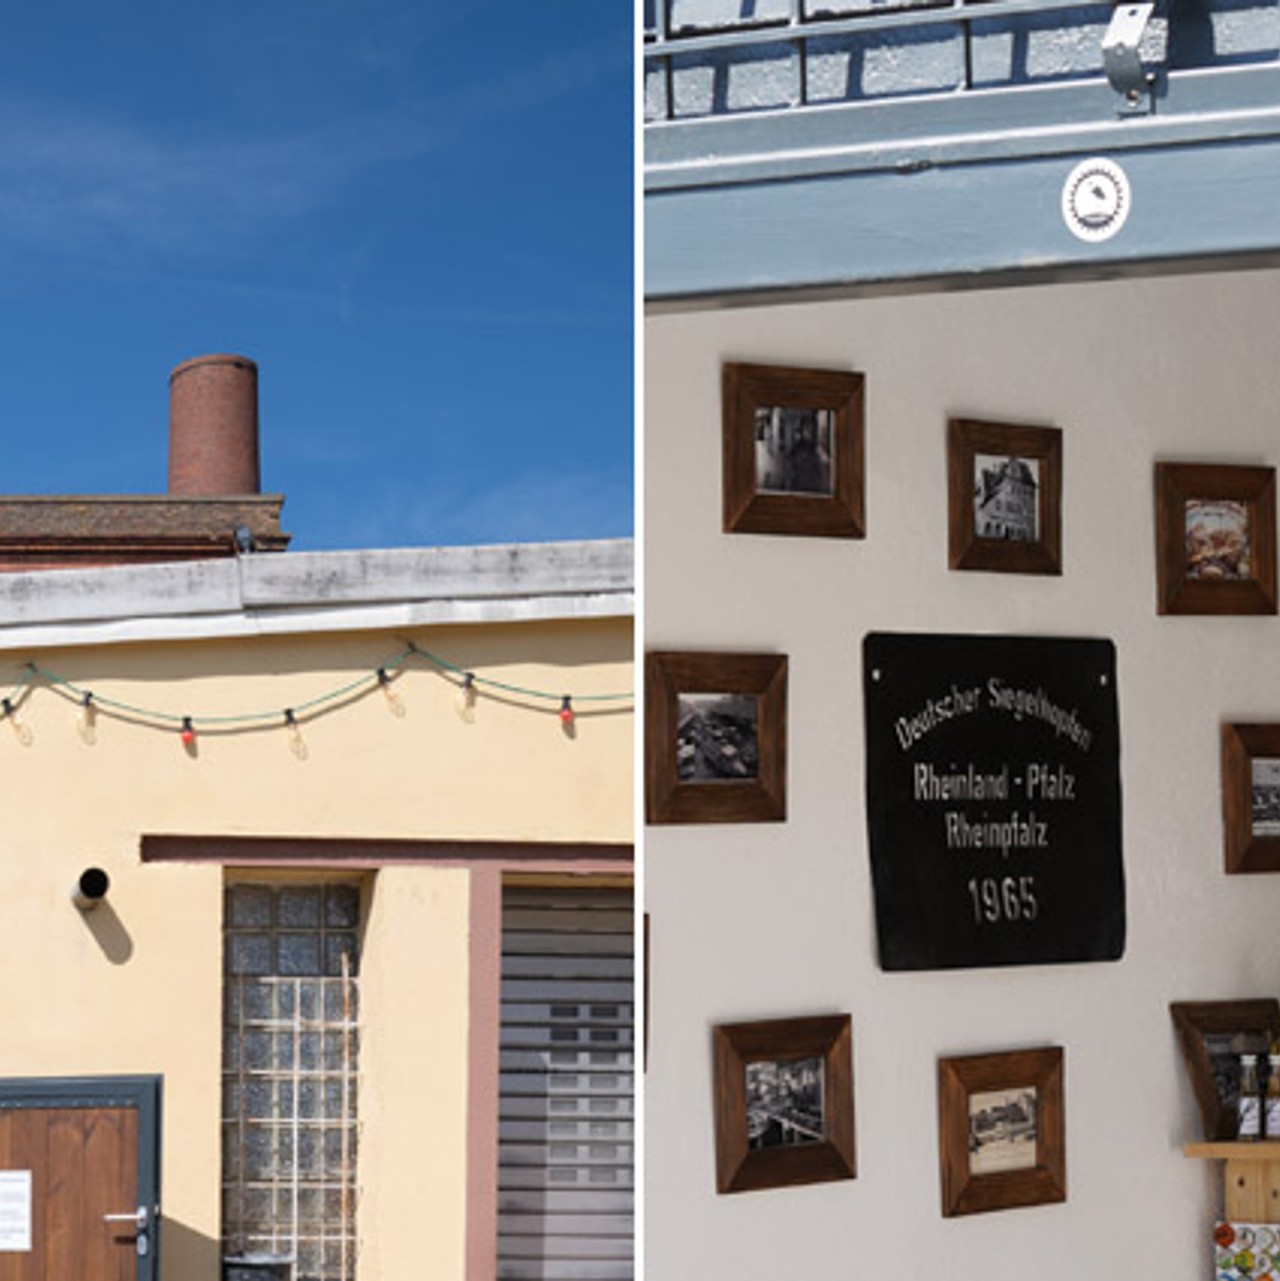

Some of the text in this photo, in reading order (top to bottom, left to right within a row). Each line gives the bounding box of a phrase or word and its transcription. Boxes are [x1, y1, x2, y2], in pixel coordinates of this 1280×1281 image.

[894, 685, 982, 750] Deutscher
[913, 762, 1009, 800] Rheinland
[1026, 762, 1076, 800] Pfalz
[945, 811, 1048, 858] Rheinpfalz
[968, 876, 1038, 922] 1965
